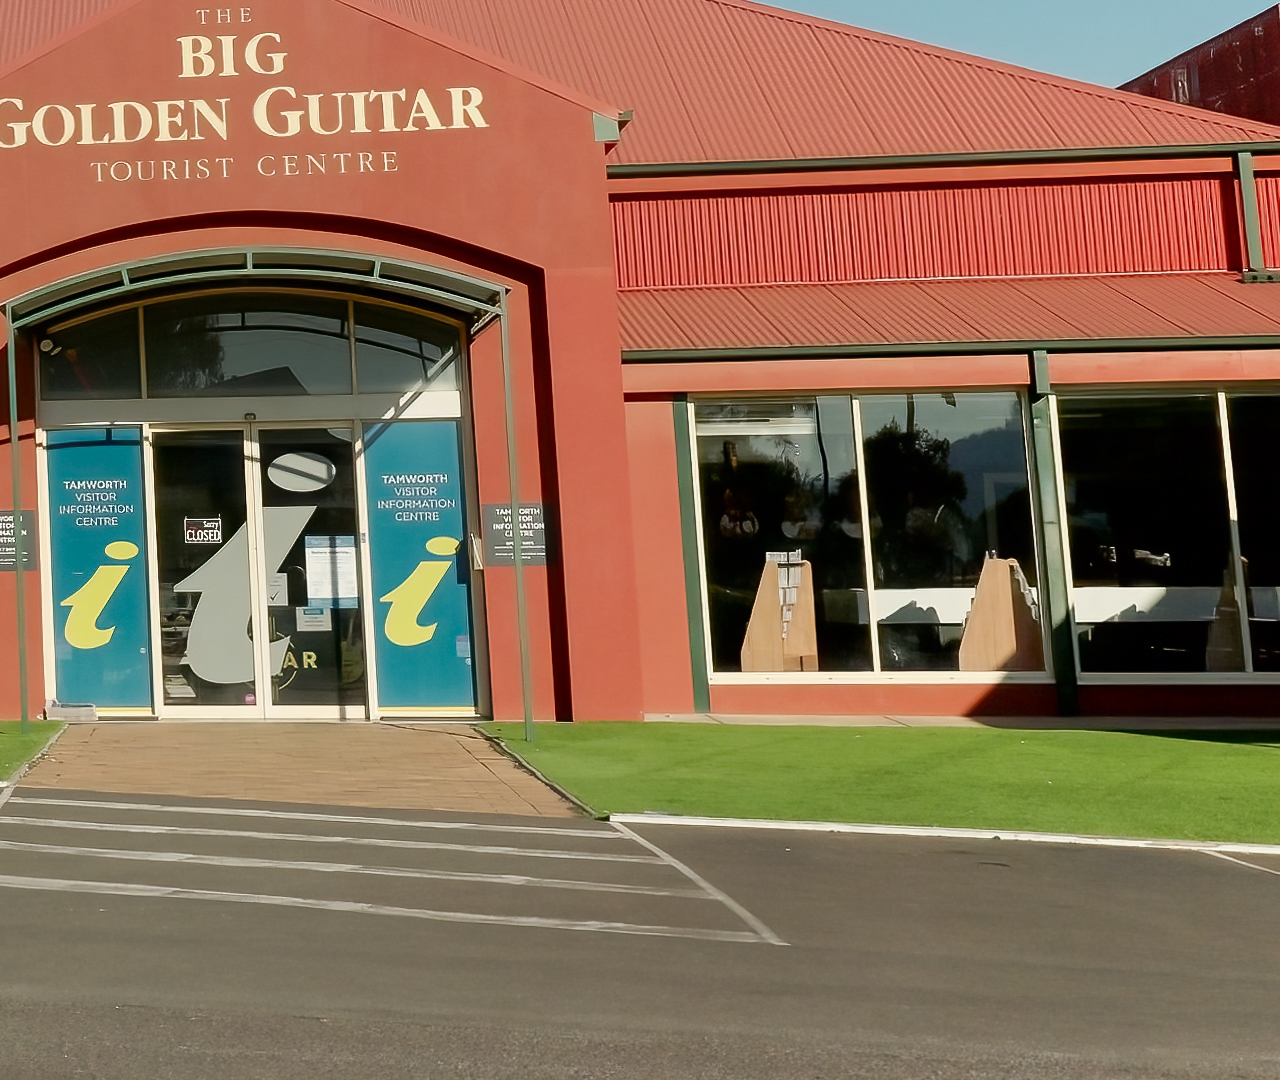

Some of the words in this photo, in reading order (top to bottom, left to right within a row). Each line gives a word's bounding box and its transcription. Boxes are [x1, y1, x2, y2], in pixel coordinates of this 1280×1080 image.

[196, 8, 252, 24] THE
[177, 32, 288, 78] BIG
[252, 86, 490, 138] GUITAR
[90, 157, 234, 183] TOURIST
[257, 151, 400, 178] CENTRE
[382, 474, 448, 484] TAMWORTH
[63, 480, 127, 490] TAMWORTH
[394, 487, 437, 496] VISITOR
[75, 492, 117, 502] VISITOR
[377, 499, 455, 509] INFORMATION
[60, 504, 134, 515] INFORMATION
[75, 517, 119, 526] CENTRE
[395, 512, 440, 521] CENTRE
[186, 529, 220, 541] CLOSED
